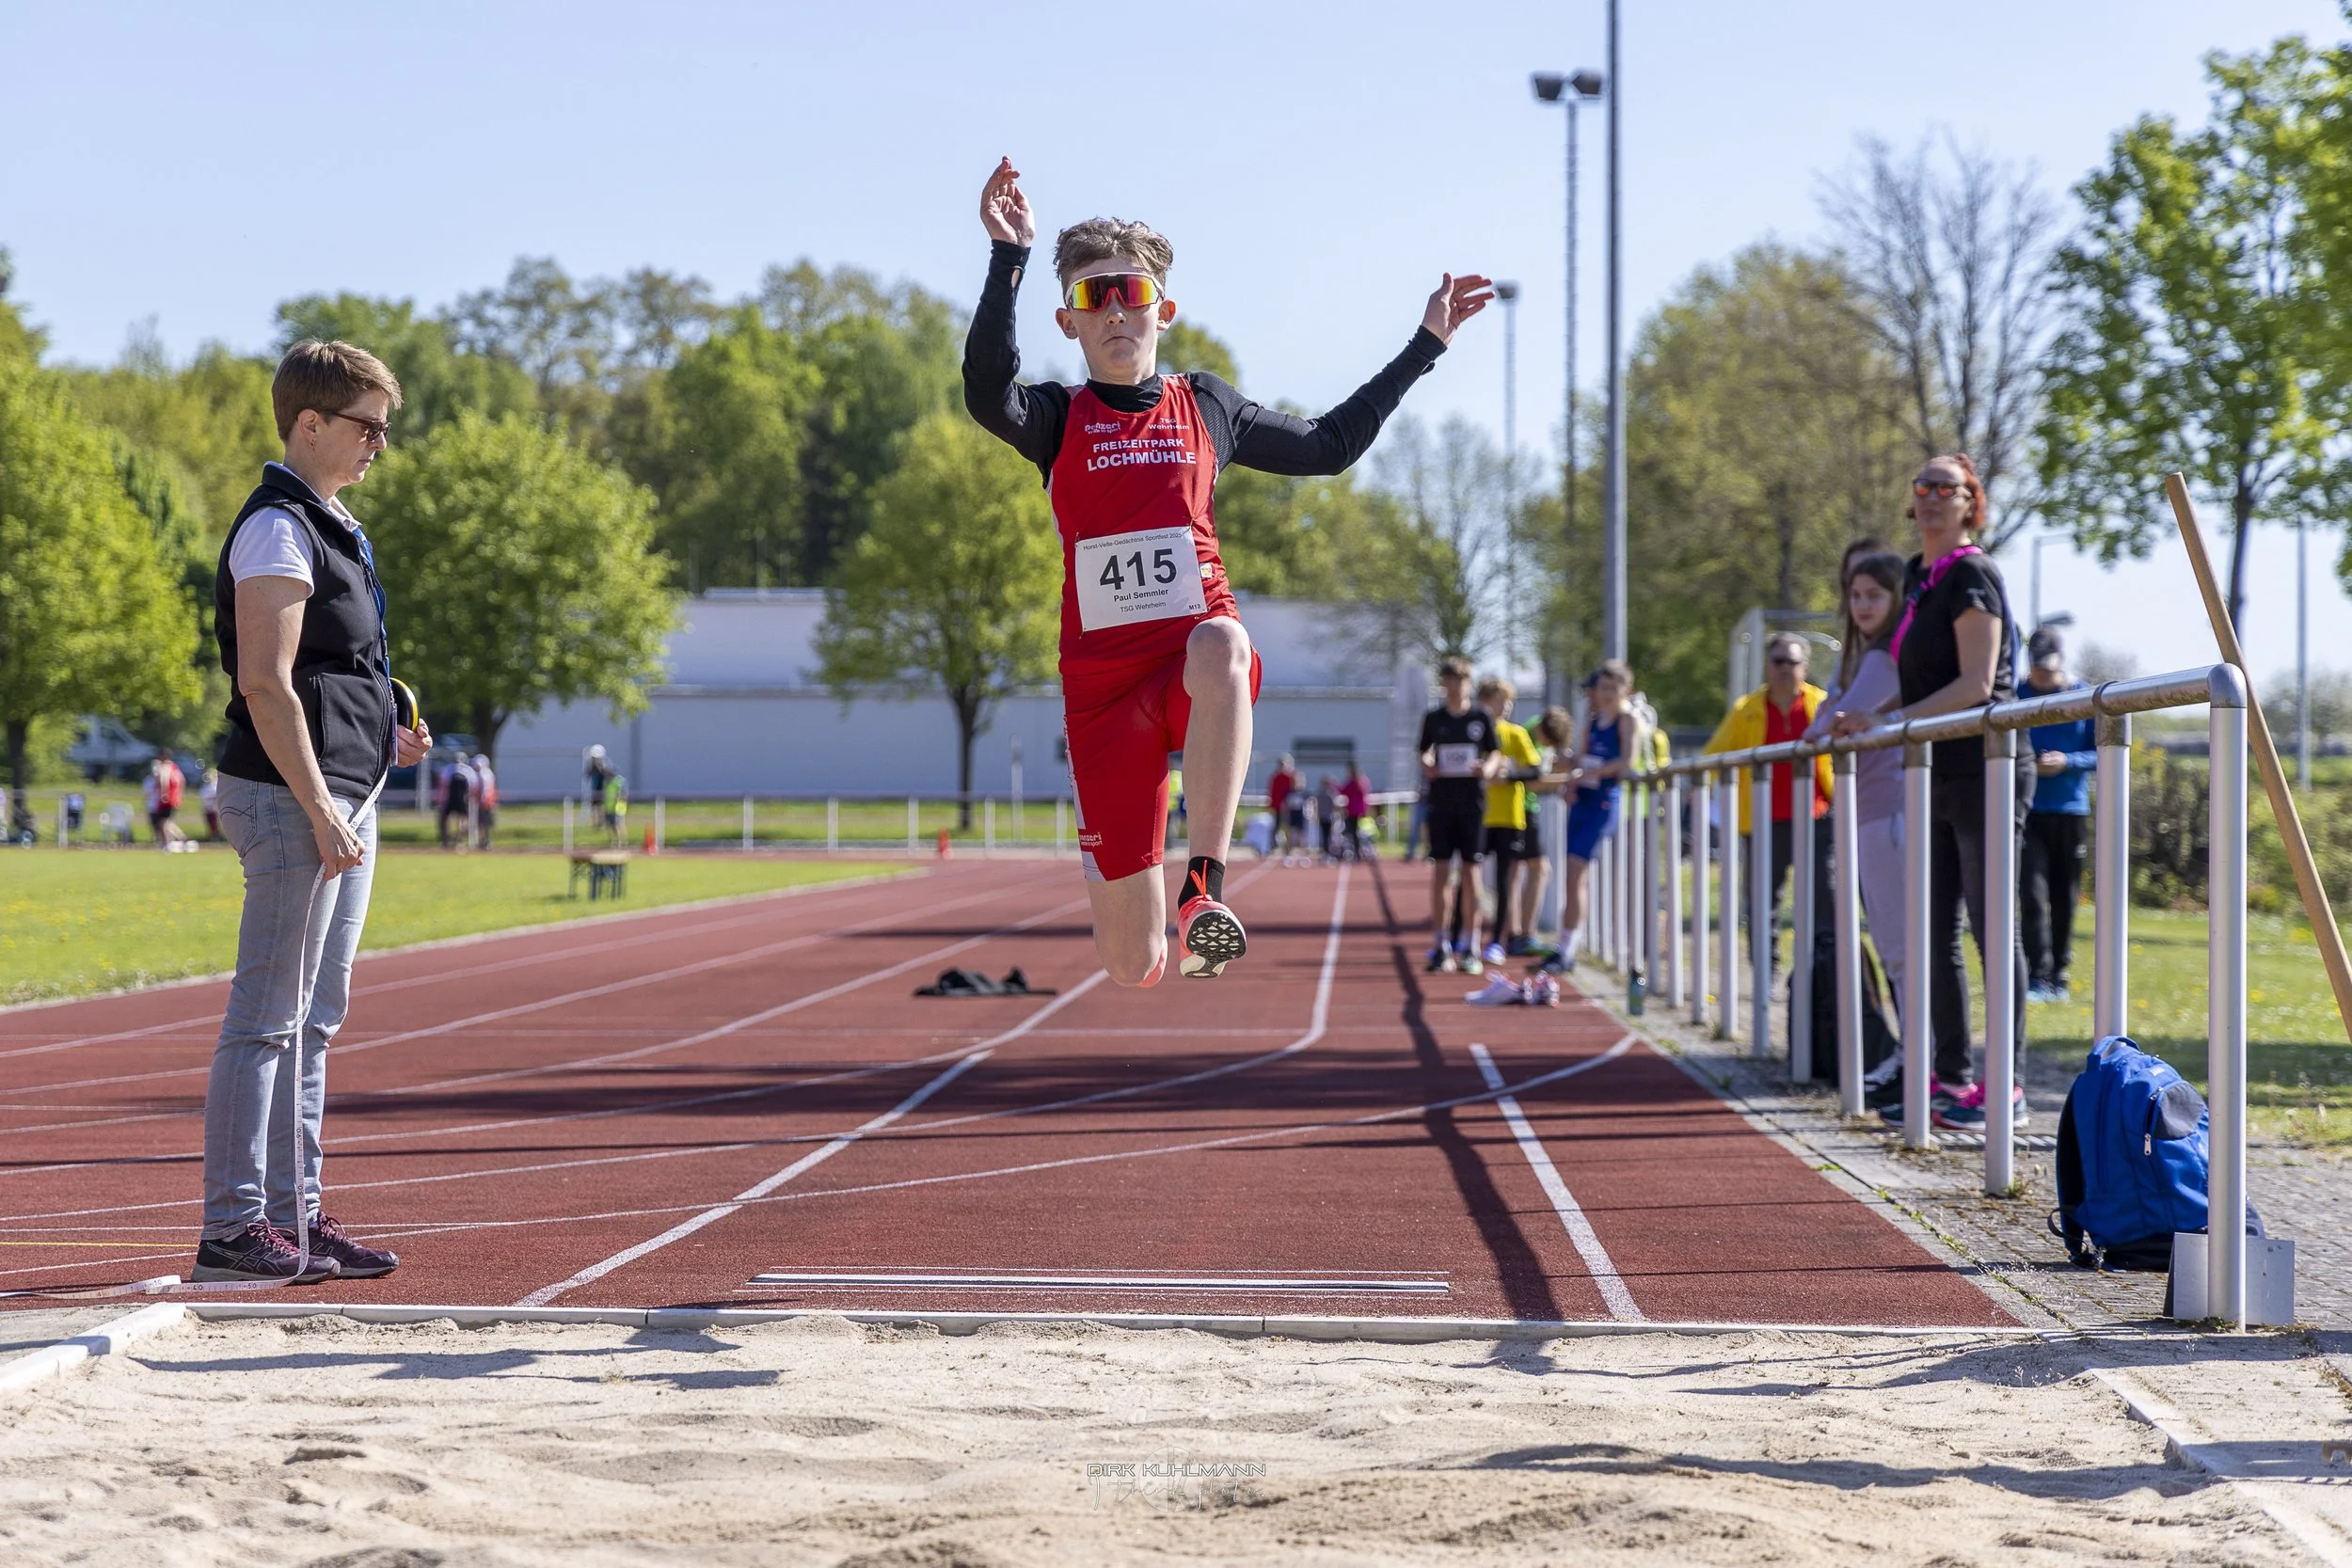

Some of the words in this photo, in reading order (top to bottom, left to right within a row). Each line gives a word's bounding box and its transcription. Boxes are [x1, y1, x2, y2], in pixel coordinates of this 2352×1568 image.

[1093, 438, 1185, 452] FREIZEITPARK
[1087, 450, 1197, 471] LOCHMÜHLE
[1145, 533, 1168, 542] Sportfest
[1100, 548, 1177, 590] 415
[1114, 593, 1132, 602] Paul
[1133, 589, 1168, 599] Semmler
[1135, 602, 1167, 610] Wehrheim
